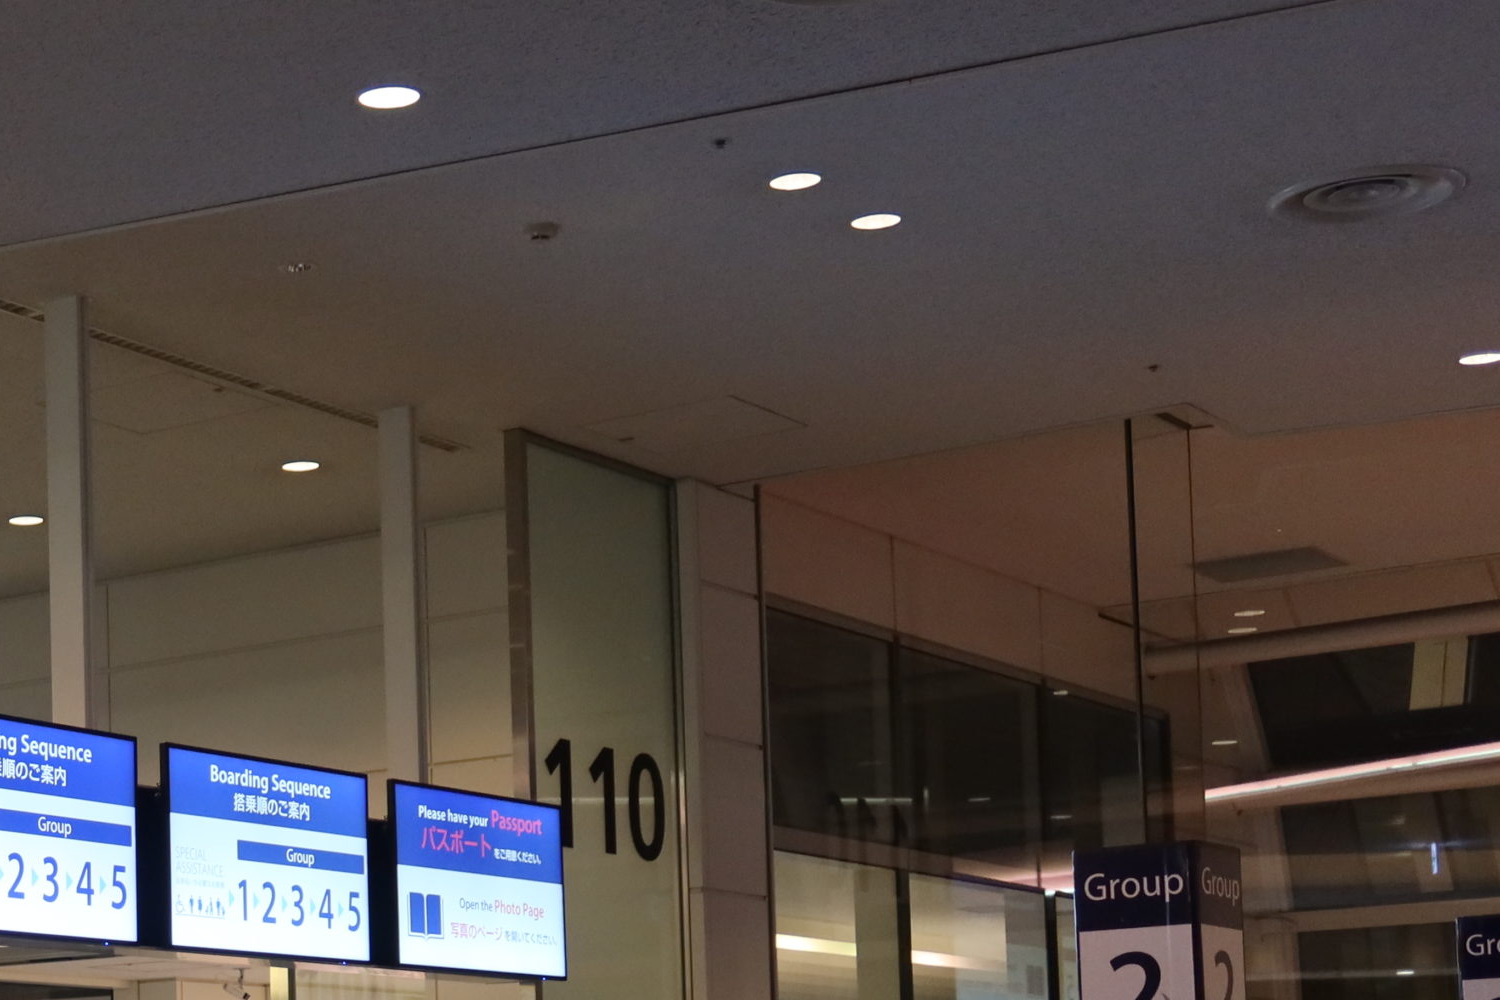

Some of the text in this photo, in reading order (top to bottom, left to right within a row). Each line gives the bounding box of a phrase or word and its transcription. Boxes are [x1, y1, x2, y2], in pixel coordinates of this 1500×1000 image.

[20, 734, 93, 763] Sequence
[209, 763, 331, 799] Boarding Sequence
[233, 792, 311, 822] 搭乗順のご案内
[544, 738, 666, 862] 110
[37, 816, 73, 838] Group
[418, 804, 543, 837] Please have your Passport
[286, 848, 315, 868] Group
[7, 852, 26, 900] 2
[42, 856, 60, 903] 3
[76, 861, 95, 906] 4
[111, 864, 127, 910] 5
[1083, 872, 1184, 903] Group
[1201, 866, 1240, 906] Group
[238, 879, 361, 932] 1 2 3 4 5
[459, 897, 545, 921] Open the Photo Page
